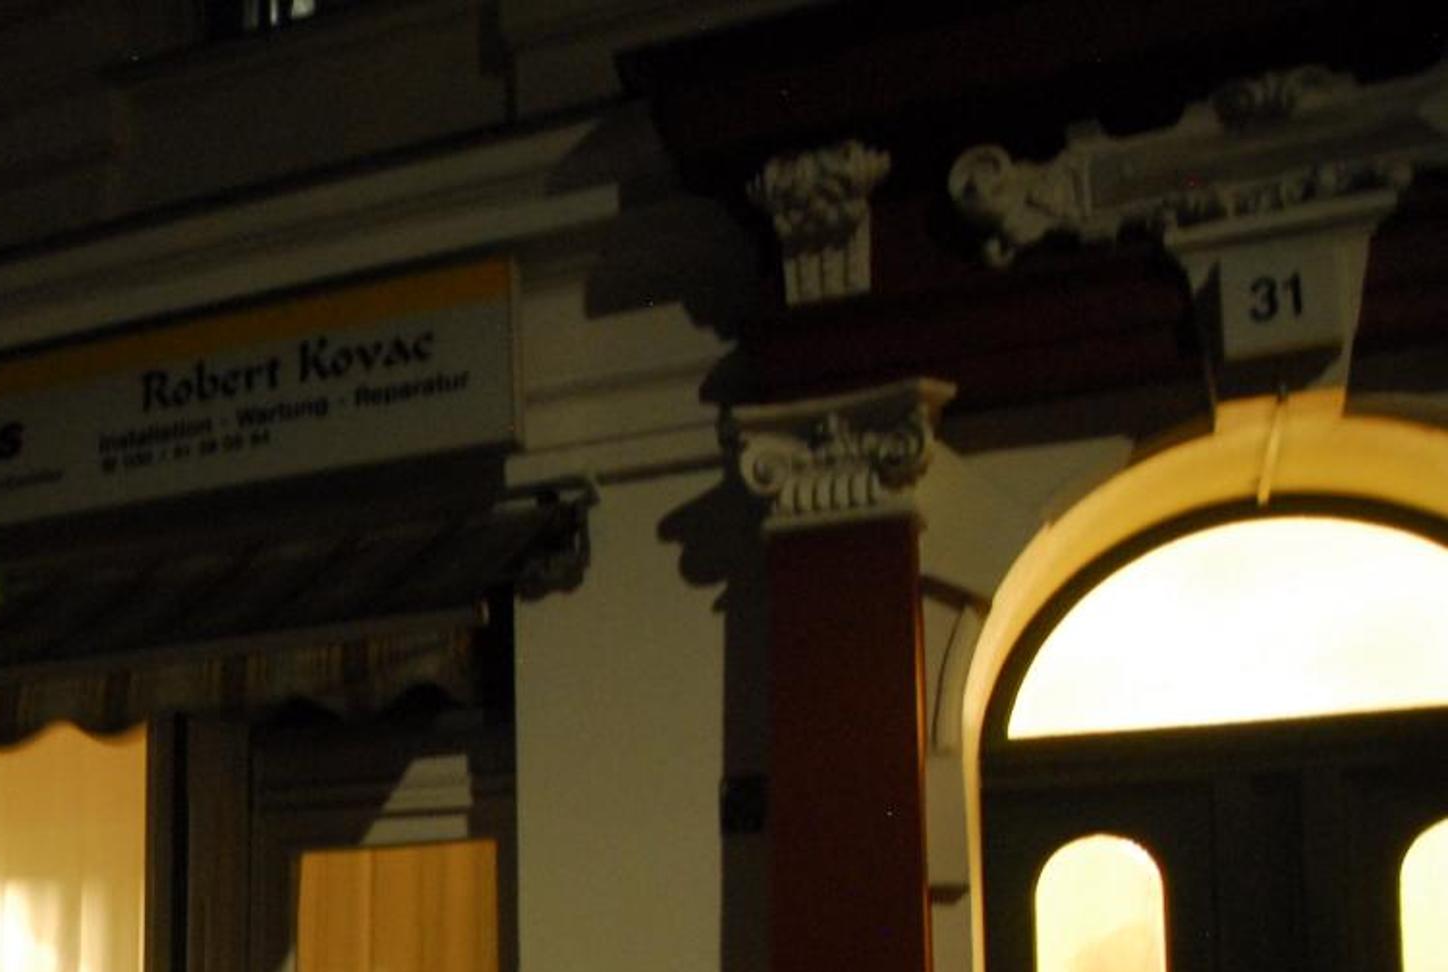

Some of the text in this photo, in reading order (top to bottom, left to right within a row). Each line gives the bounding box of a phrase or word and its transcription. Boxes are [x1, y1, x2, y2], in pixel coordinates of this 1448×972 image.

[1249, 271, 1303, 323] 31
[139, 332, 434, 411] Robert Kovac
[99, 415, 213, 454] Installation
[237, 396, 329, 430] Wartung
[355, 370, 470, 408] Reparatur
